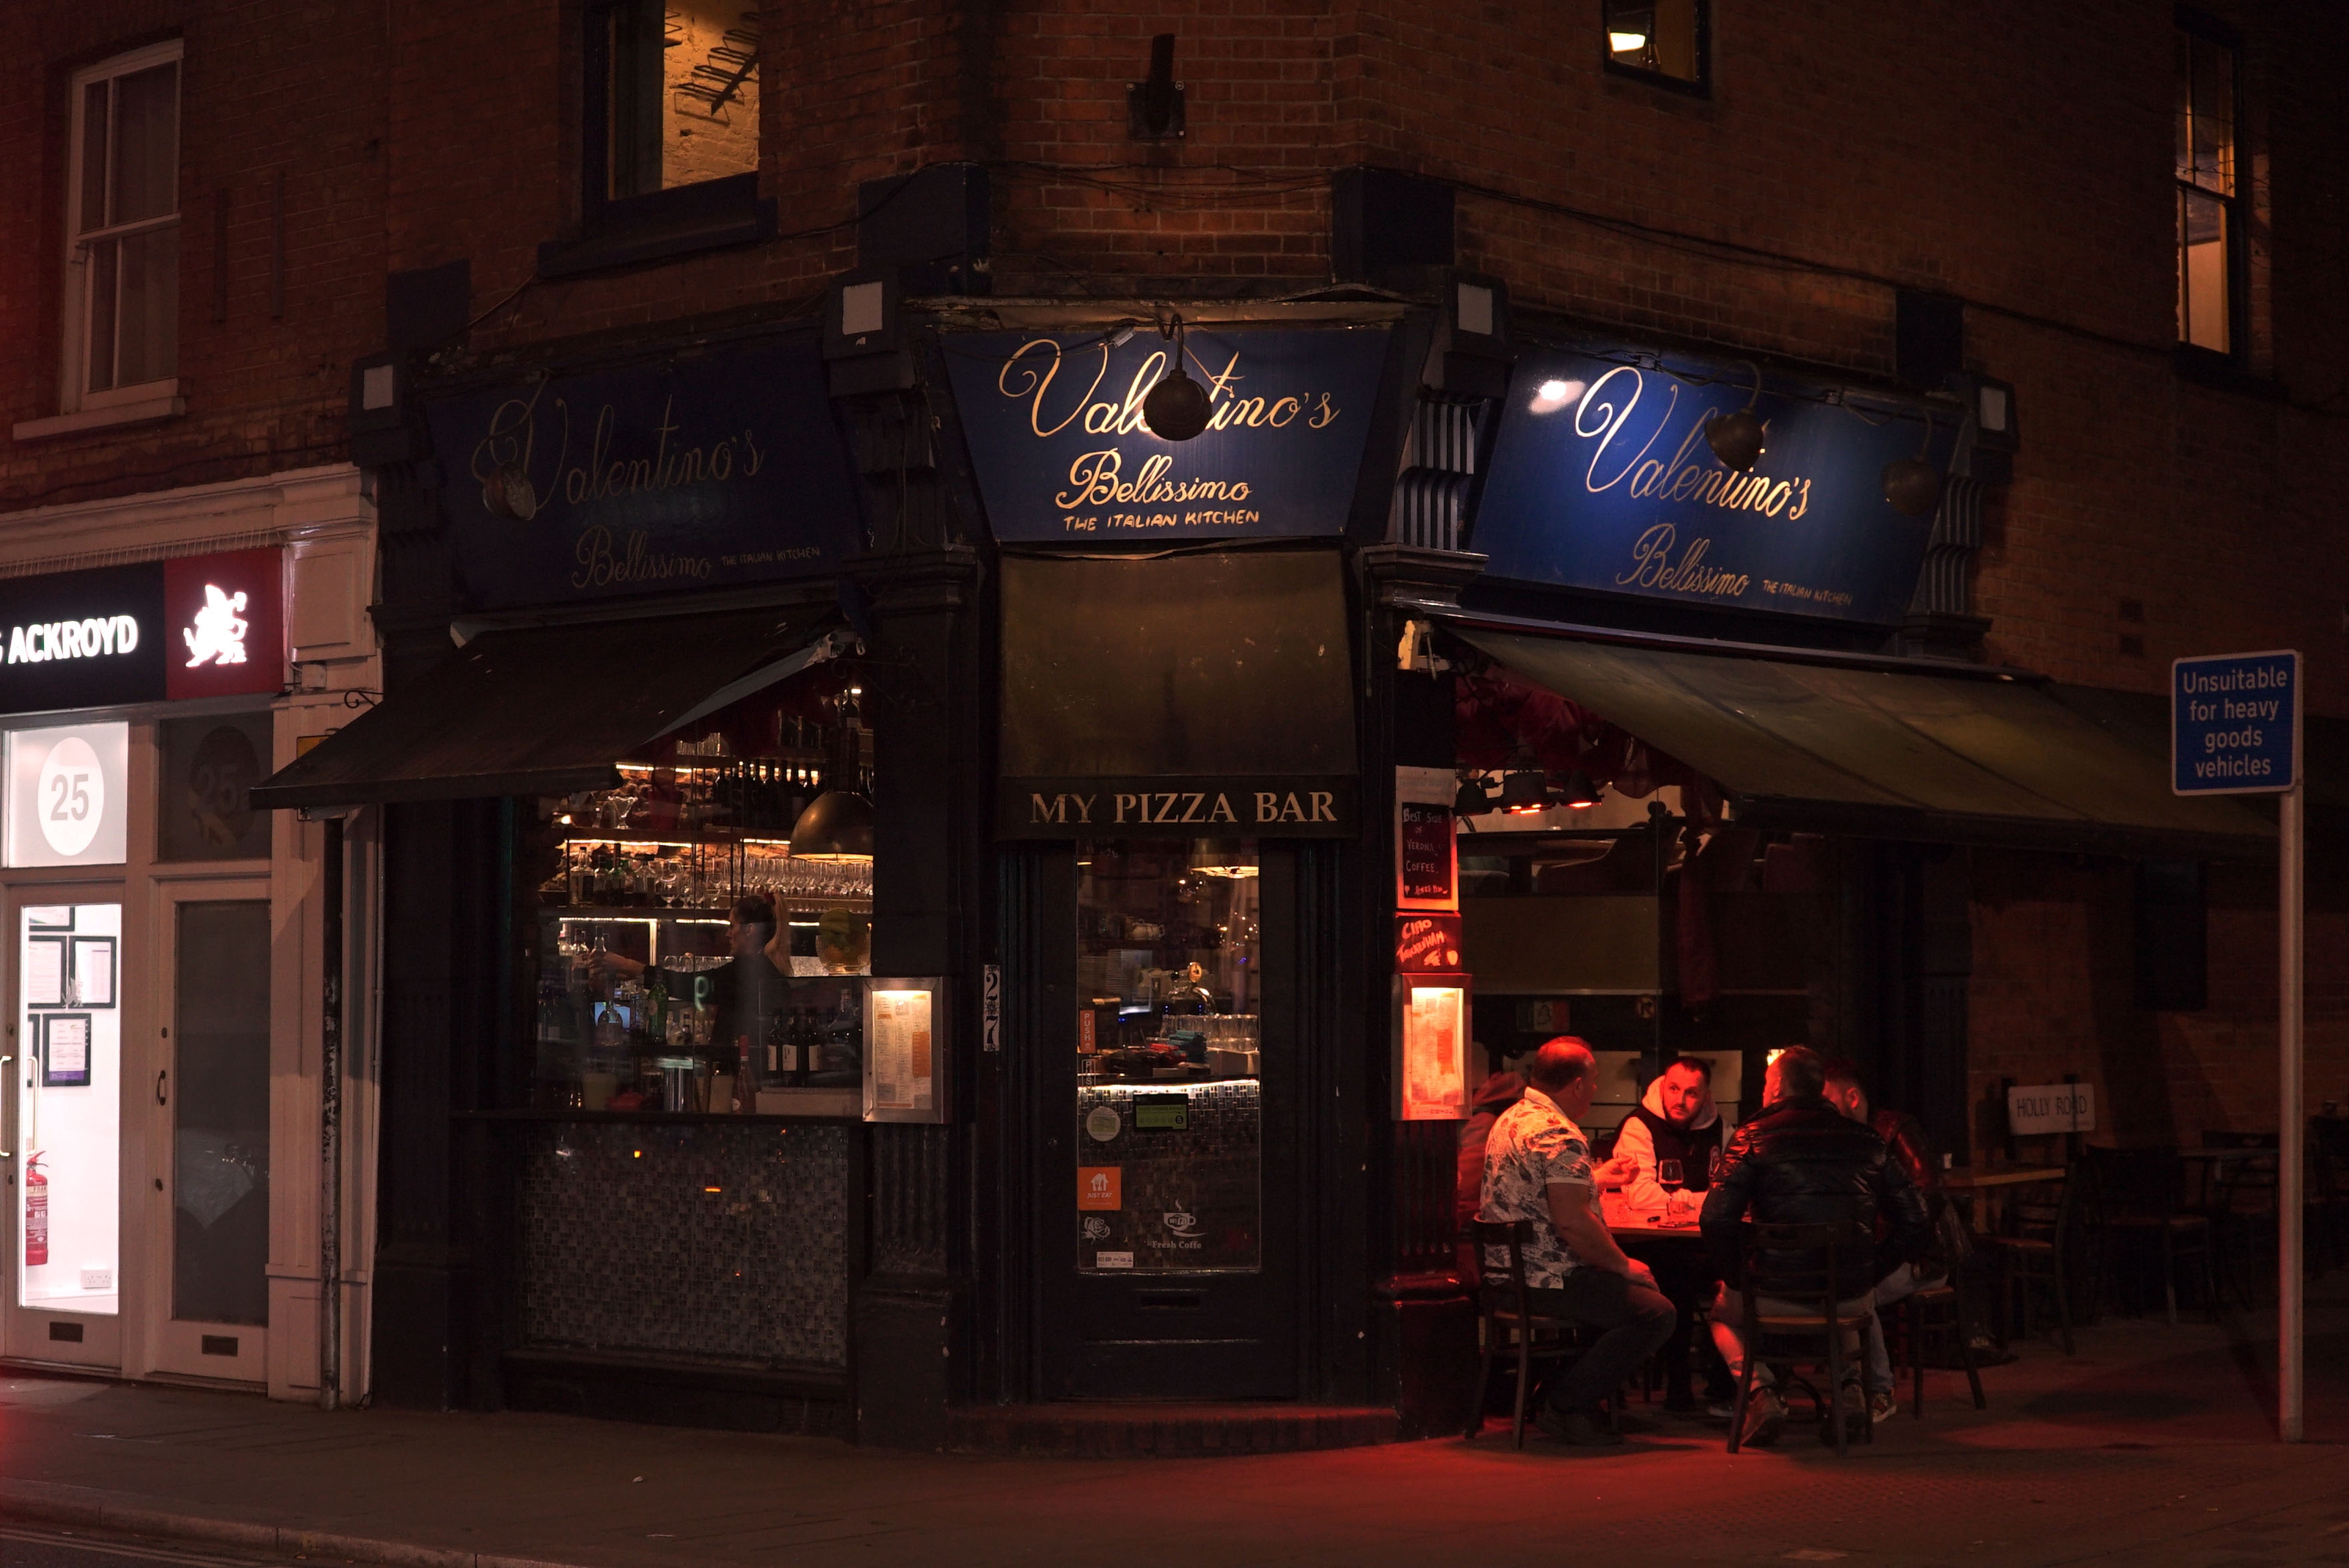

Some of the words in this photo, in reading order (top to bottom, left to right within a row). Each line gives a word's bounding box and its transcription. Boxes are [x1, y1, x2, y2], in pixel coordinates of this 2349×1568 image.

[998, 339, 1340, 437] Valtino's
[488, 394, 766, 511] Valentino's
[1055, 448, 1253, 510] Bellissimo
[1063, 516, 1097, 532] THE
[1107, 514, 1177, 529] ITALIAN
[1185, 509, 1260, 526] KITCHEN
[571, 524, 712, 589] Bellissimo
[721, 553, 738, 567] THE
[739, 551, 774, 565] ITALIAN
[775, 546, 822, 563] KITCHEN
[1615, 522, 1750, 597] Bellissimo
[1762, 579, 1779, 593] THE
[1779, 582, 1812, 601] ITALIAN
[1813, 589, 1853, 607] KITCHEN
[8, 615, 139, 664] ACKROYD
[2183, 666, 2287, 693] Unsuitable
[2190, 700, 2217, 721] for
[2224, 698, 2279, 721] heavy
[2205, 725, 2263, 753] goods
[2196, 755, 2271, 777] vehicles
[51, 774, 89, 821] 25
[1030, 793, 1097, 824] MY
[1114, 792, 1239, 824] PIZZA
[1254, 791, 1338, 823] BAR
[1401, 919, 1433, 939] CIAO
[2017, 1097, 2051, 1117] HOLLY
[1101, 1192, 1114, 1200] EAT
[1152, 1240, 1177, 1249] Fresh
[1178, 1240, 1203, 1250] Coffe
